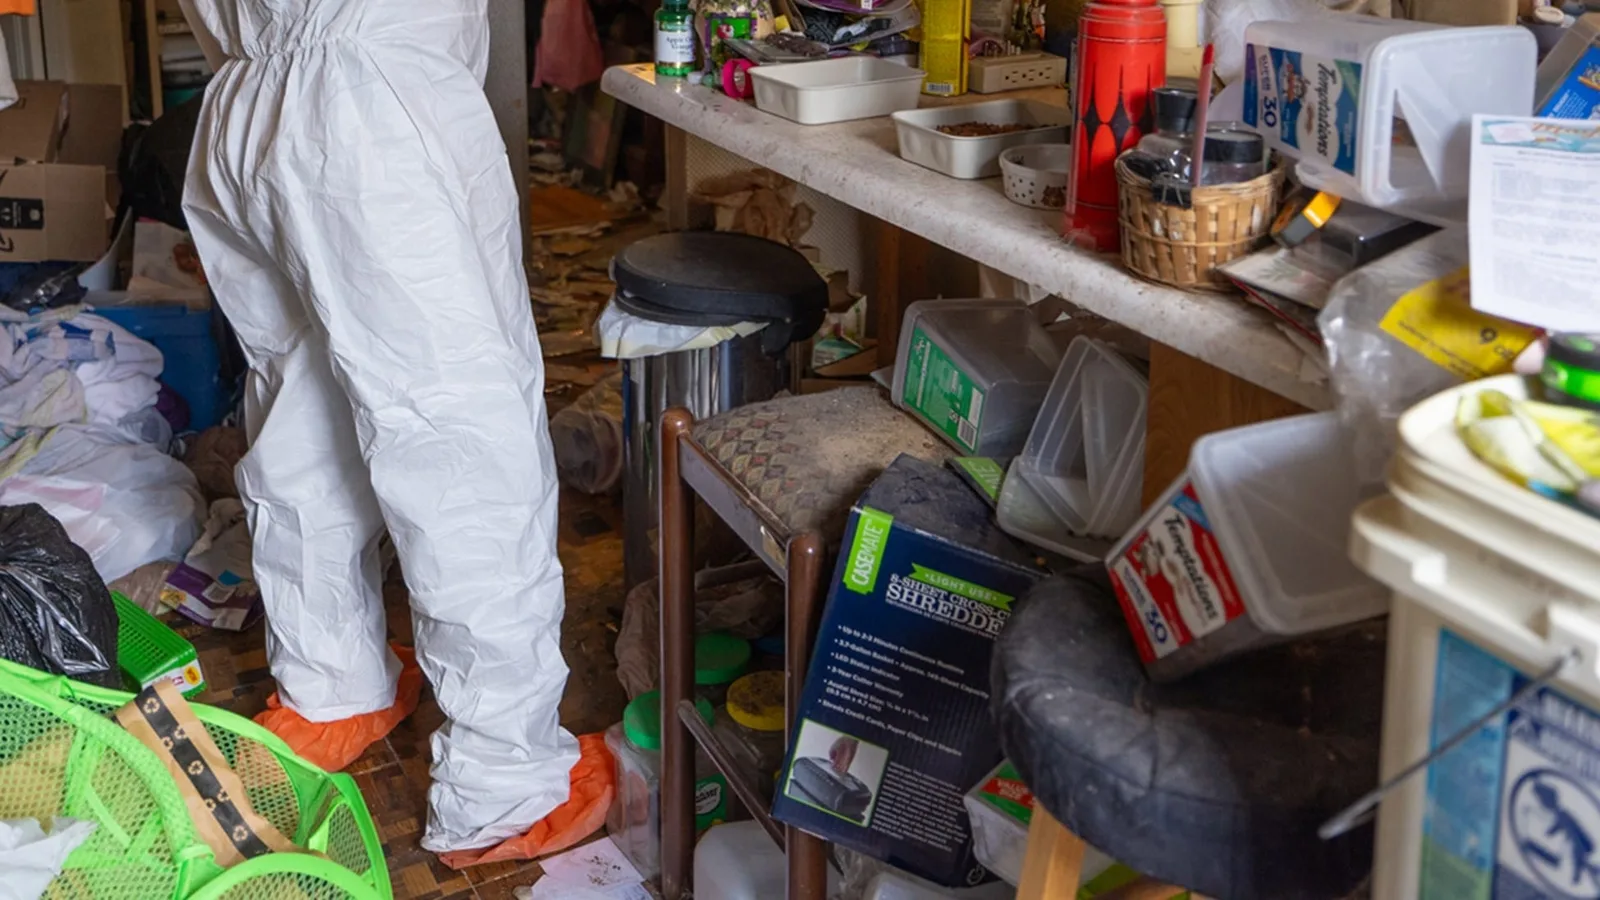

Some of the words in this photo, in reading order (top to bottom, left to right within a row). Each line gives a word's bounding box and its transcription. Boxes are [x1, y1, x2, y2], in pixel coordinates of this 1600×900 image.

[1263, 97, 1277, 128] 30
[1315, 63, 1337, 156] Temptations
[851, 520, 883, 586] CASEMATE
[1164, 513, 1218, 619] Temptations
[889, 573, 948, 599] 8-SHEET
[947, 594, 1010, 620] CROSS-C
[929, 573, 964, 591] LIGHT
[968, 587, 992, 601] USE
[886, 583, 1004, 635] SHREDDE
[1146, 605, 1167, 643] 30
[841, 625, 852, 635] Up
[852, 630, 861, 638] to
[873, 638, 898, 650] Minutes
[899, 647, 935, 664] Continuous
[835, 654, 848, 662] LED
[849, 659, 869, 670] Status
[871, 666, 899, 680] Indicator
[852, 675, 872, 685] Cutter
[872, 652, 894, 663] Basket
[960, 684, 989, 699] Capacity
[822, 700, 844, 712] Shreds
[845, 708, 864, 719] Credit
